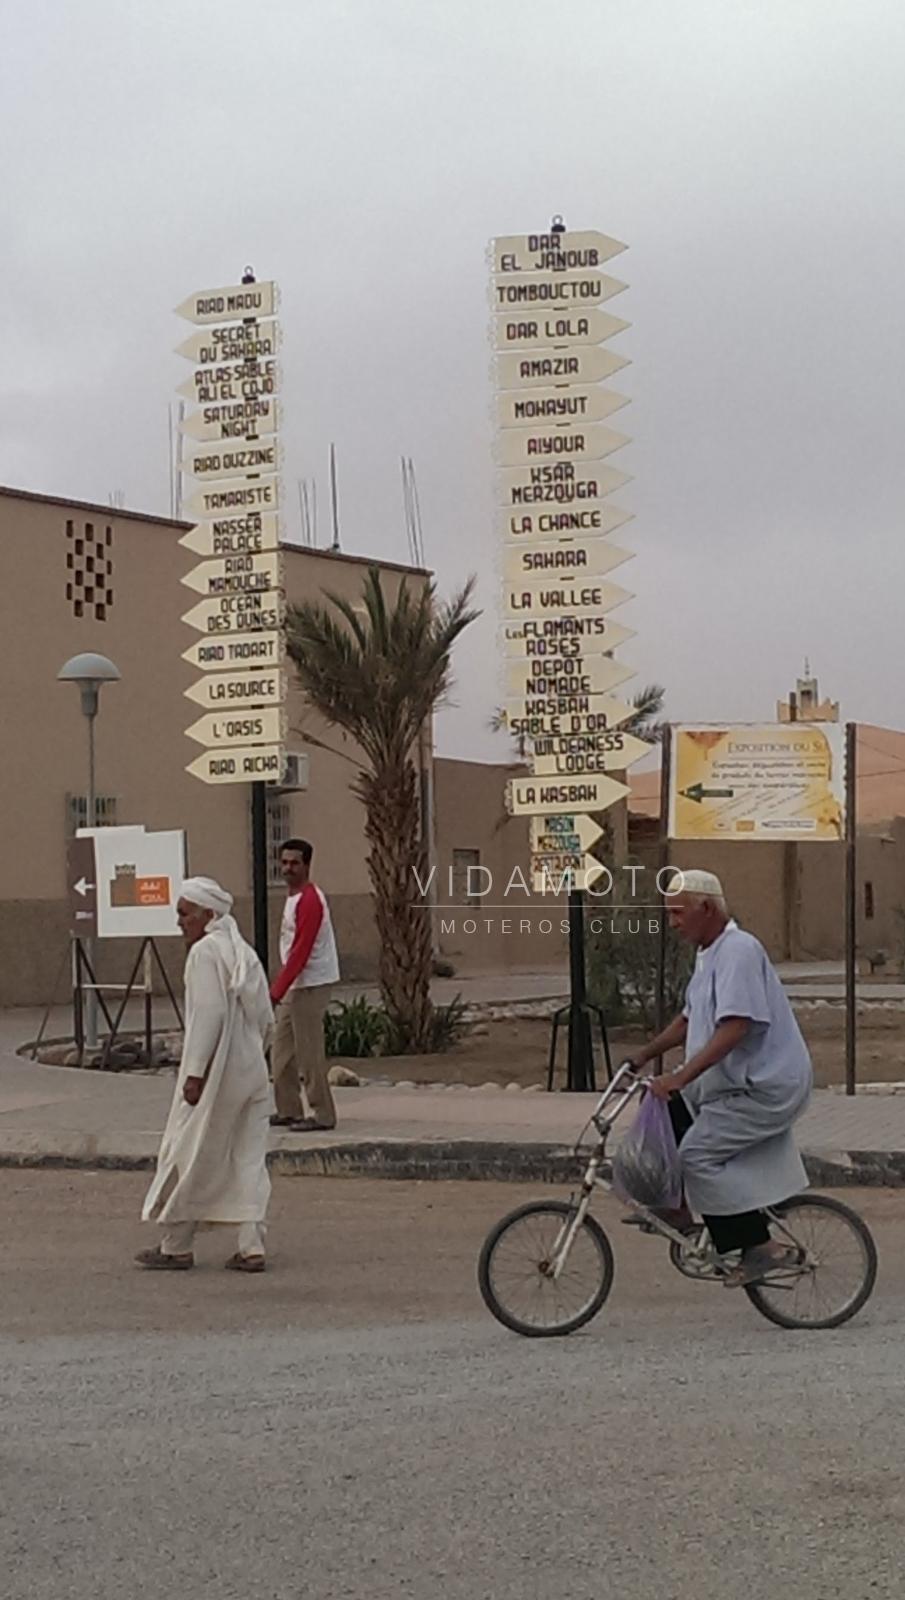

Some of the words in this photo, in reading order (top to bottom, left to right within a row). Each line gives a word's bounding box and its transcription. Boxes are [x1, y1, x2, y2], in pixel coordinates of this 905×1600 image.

[528, 234, 561, 252] DAR
[500, 254, 521, 271] EL
[535, 249, 599, 270] JANOUB
[496, 280, 602, 302] TOMBOUCTOU
[196, 298, 225, 315] RIAD
[212, 324, 261, 344] SECRET
[506, 322, 538, 340] DAR
[545, 319, 589, 337] LOLA
[200, 347, 217, 363] DU
[221, 339, 271, 360] SAHARA
[520, 357, 579, 378] AMAZIR
[221, 384, 236, 400] EL
[203, 401, 269, 424] SATURDAY
[514, 396, 588, 418] MOHAYUT
[221, 420, 257, 439] NIGHT
[527, 435, 585, 455] AIYOUR
[193, 455, 221, 473] RIAD
[223, 447, 275, 469] OUZZINE
[531, 464, 575, 484] KSAR
[203, 487, 271, 510] TAMARISTE
[511, 480, 598, 504] MERZOUGA
[213, 517, 262, 537] NASSER
[511, 516, 532, 534] LA
[538, 510, 601, 532] CHANCE
[213, 533, 262, 554] PALACE
[225, 556, 254, 574] RIAD
[522, 549, 587, 571] SAHARA
[208, 570, 271, 594] MAMOUCHE
[221, 596, 262, 614] OCEAN
[511, 591, 532, 610] LA
[539, 588, 602, 608] VALLEE
[208, 614, 231, 632] DES
[236, 609, 277, 629] DUNES
[523, 617, 605, 639] FLAMANTS
[198, 645, 225, 663] RIAD
[228, 640, 275, 661] TADART
[526, 637, 581, 657] ROSES
[531, 657, 584, 677] DEPOT
[209, 684, 226, 700] LA
[227, 680, 275, 699] SOURCE
[526, 676, 590, 695] NOMADE
[525, 697, 590, 716] KASBAH
[212, 719, 263, 738] L'OASIS
[510, 716, 561, 736] SABLE
[570, 713, 607, 734] D'OR
[534, 734, 624, 756] WILDERNESS
[209, 759, 236, 775] RIAD
[242, 755, 279, 773] AICHA
[555, 753, 605, 772] LODGE
[516, 787, 536, 805] LA
[540, 784, 598, 803] KASBAH
